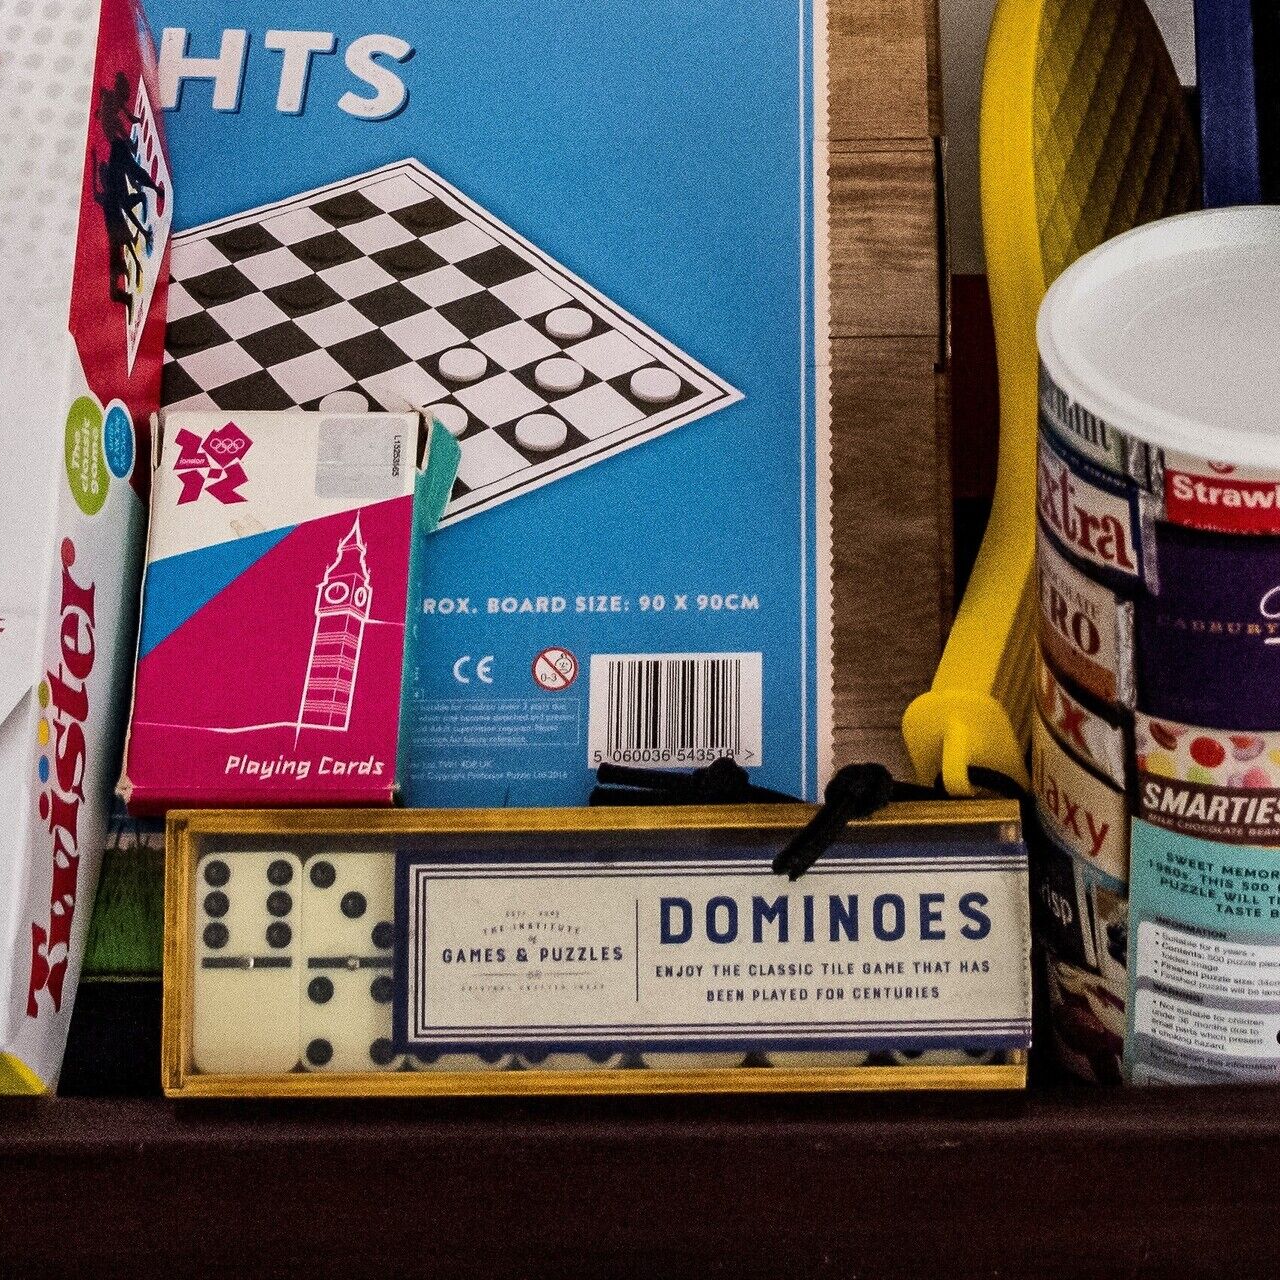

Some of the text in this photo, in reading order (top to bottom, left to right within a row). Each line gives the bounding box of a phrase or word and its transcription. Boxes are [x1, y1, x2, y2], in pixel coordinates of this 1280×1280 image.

[423, 593, 759, 614] ROX. BOARD SIZE: 90 X 90CM
[593, 748, 735, 763] 5 060036 543518
[224, 754, 311, 780] Playing
[317, 754, 384, 775] Cards
[27, 536, 96, 1018] Twister
[1166, 852, 1214, 872] SWEET
[1160, 876, 1216, 898] PUZZLE
[1224, 891, 1260, 905] WILL
[1200, 874, 1233, 890] THIS
[1242, 880, 1269, 892] 500
[659, 891, 991, 944] DOMINOES
[1216, 902, 1262, 918] TASTE
[441, 945, 623, 964] GAMES & PUZZLES
[654, 959, 990, 978] ENJOY THE CLASSIC TILE GAME THAT HAS
[705, 985, 939, 1002] BEEN PLAYED FOR CENTURIES
